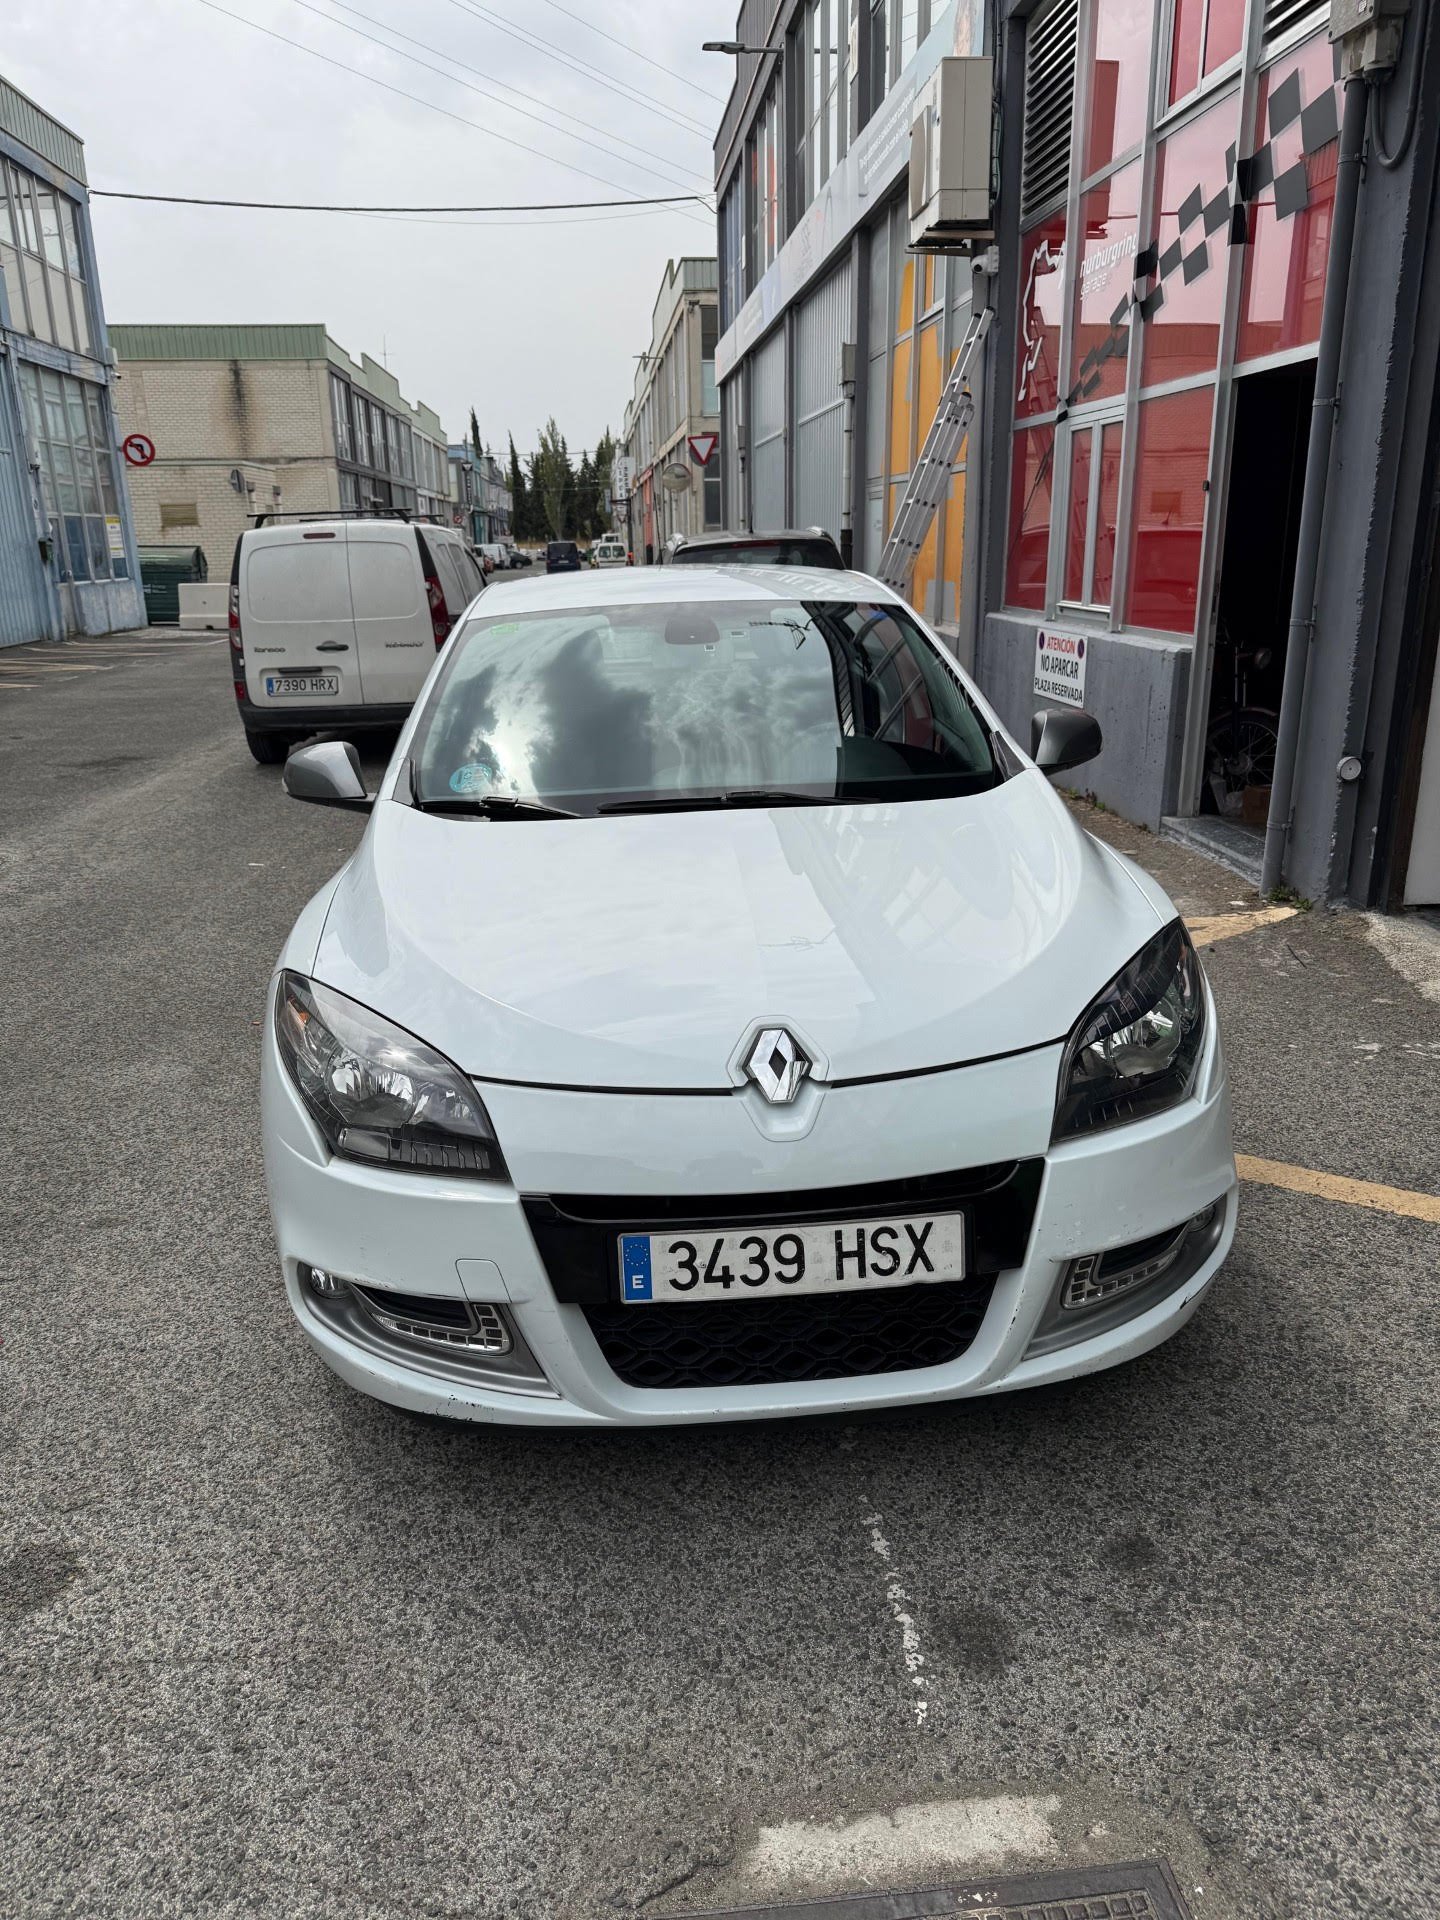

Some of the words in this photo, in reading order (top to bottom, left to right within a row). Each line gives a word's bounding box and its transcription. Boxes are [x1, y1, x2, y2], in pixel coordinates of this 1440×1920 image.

[1040, 654, 1050, 672] NO
[1050, 657, 1079, 680] APARCAR
[275, 679, 306, 692] 7390
[311, 678, 334, 691] HRX
[1034, 677, 1051, 693] PLAZA
[1051, 681, 1083, 702] RESERVADA
[668, 1233, 806, 1292] 3439
[834, 1221, 934, 1281] HSX
[632, 1274, 644, 1288] E
